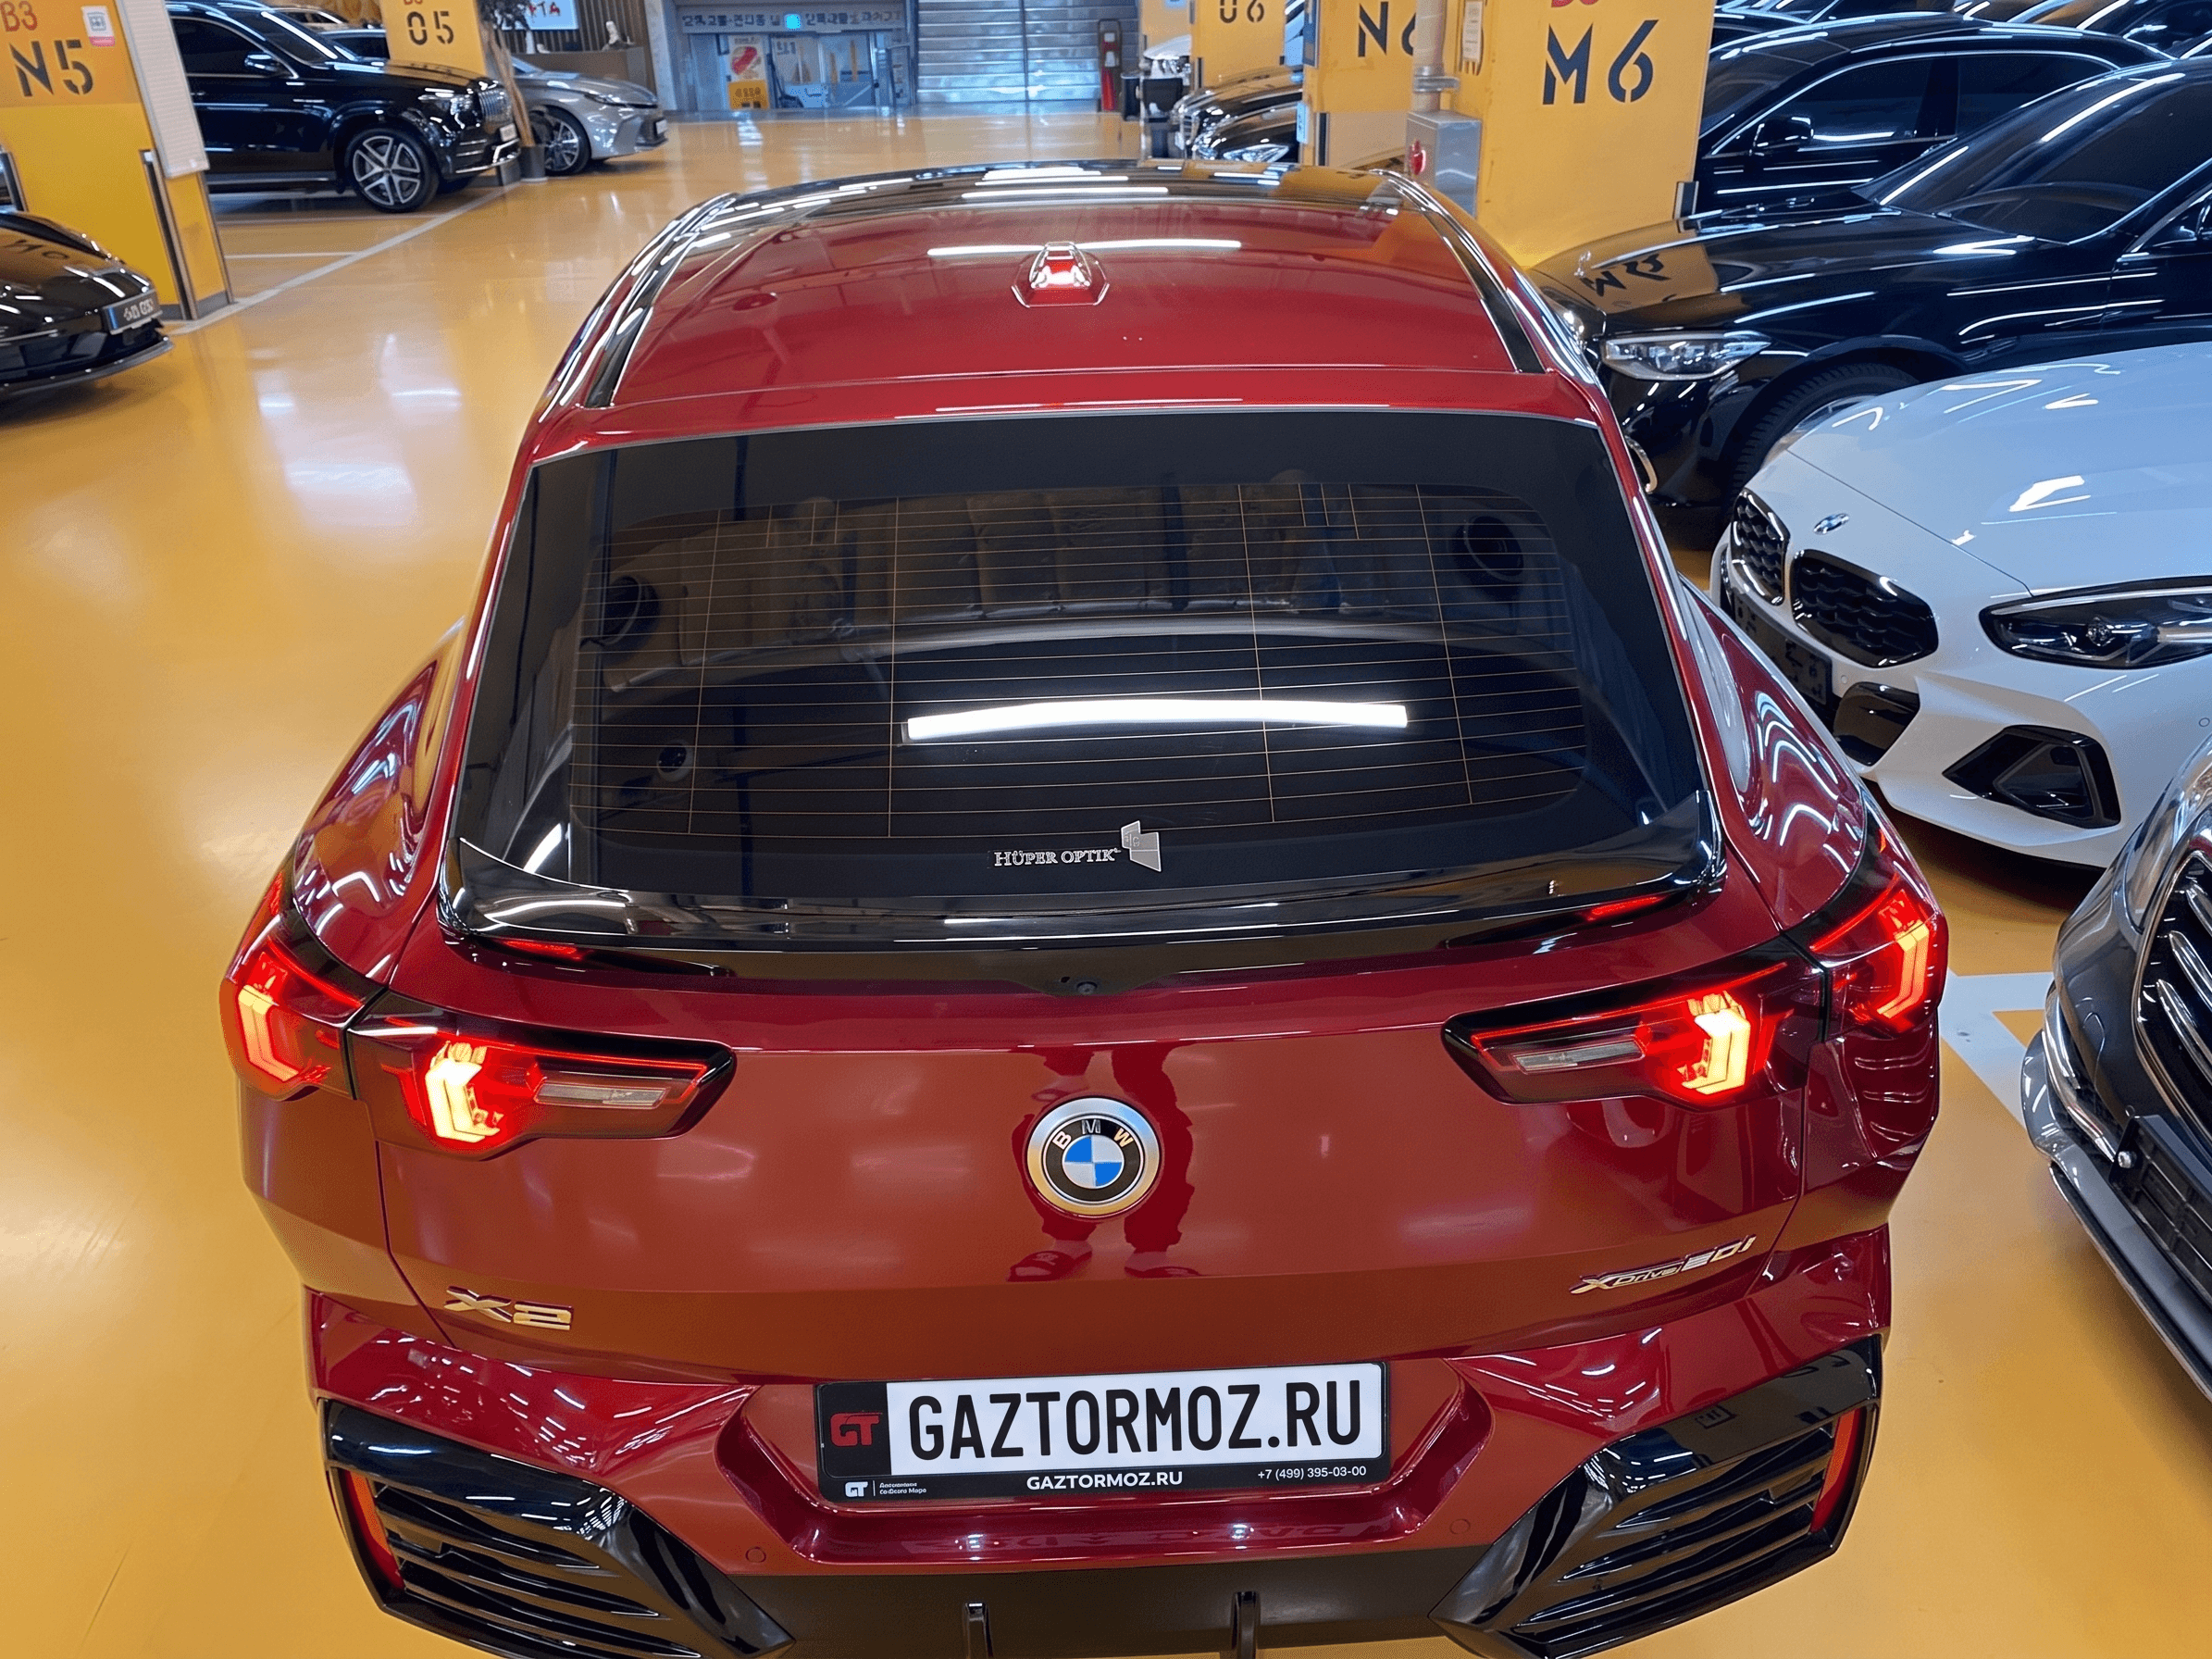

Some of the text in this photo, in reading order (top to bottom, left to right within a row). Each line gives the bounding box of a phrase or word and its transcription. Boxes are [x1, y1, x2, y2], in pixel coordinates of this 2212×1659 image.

[0, 1, 38, 31] B3
[9, 39, 93, 97] N5
[1542, 19, 1659, 106] M6
[1052, 1118, 1134, 1150] BMW
[443, 1286, 574, 1331] X2
[909, 1379, 1361, 1461] GAZTORMOZ.RU
[1026, 1471, 1184, 1491] GAZTORMOZ.RU
[1258, 1466, 1367, 1481] +7 (499) 395-03-00
